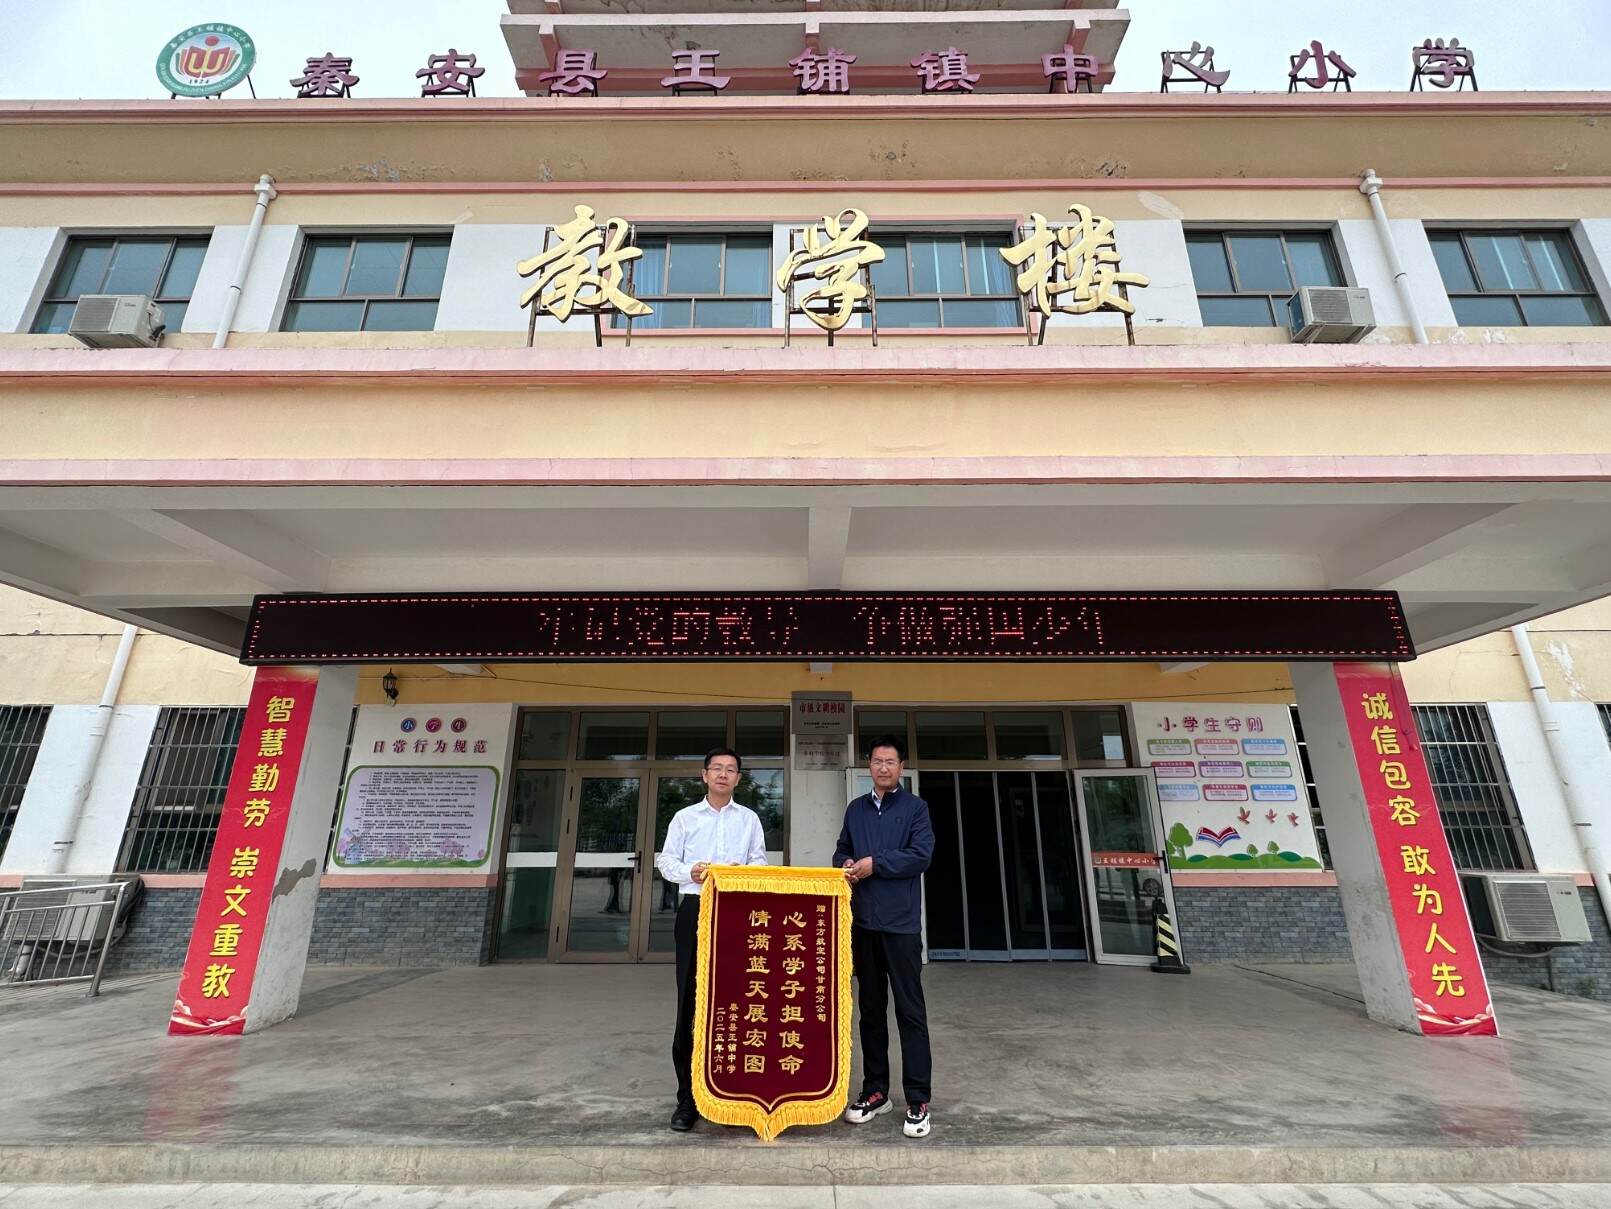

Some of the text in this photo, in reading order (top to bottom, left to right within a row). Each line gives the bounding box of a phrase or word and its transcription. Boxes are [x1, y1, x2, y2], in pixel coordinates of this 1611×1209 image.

[289, 37, 1475, 97] 秦安县王铺镇中心小学
[516, 203, 1151, 331] 教学楼
[373, 738, 488, 754] 日常行为规范
[1157, 715, 1265, 733] 小学生守则
[201, 695, 296, 999] 智慧勤劳 崇文重教
[1361, 692, 1467, 998] 诚信包容 敢为人先
[743, 909, 772, 1075] 情满蓝天展宏图
[778, 910, 807, 1076] 心系学子担使命
